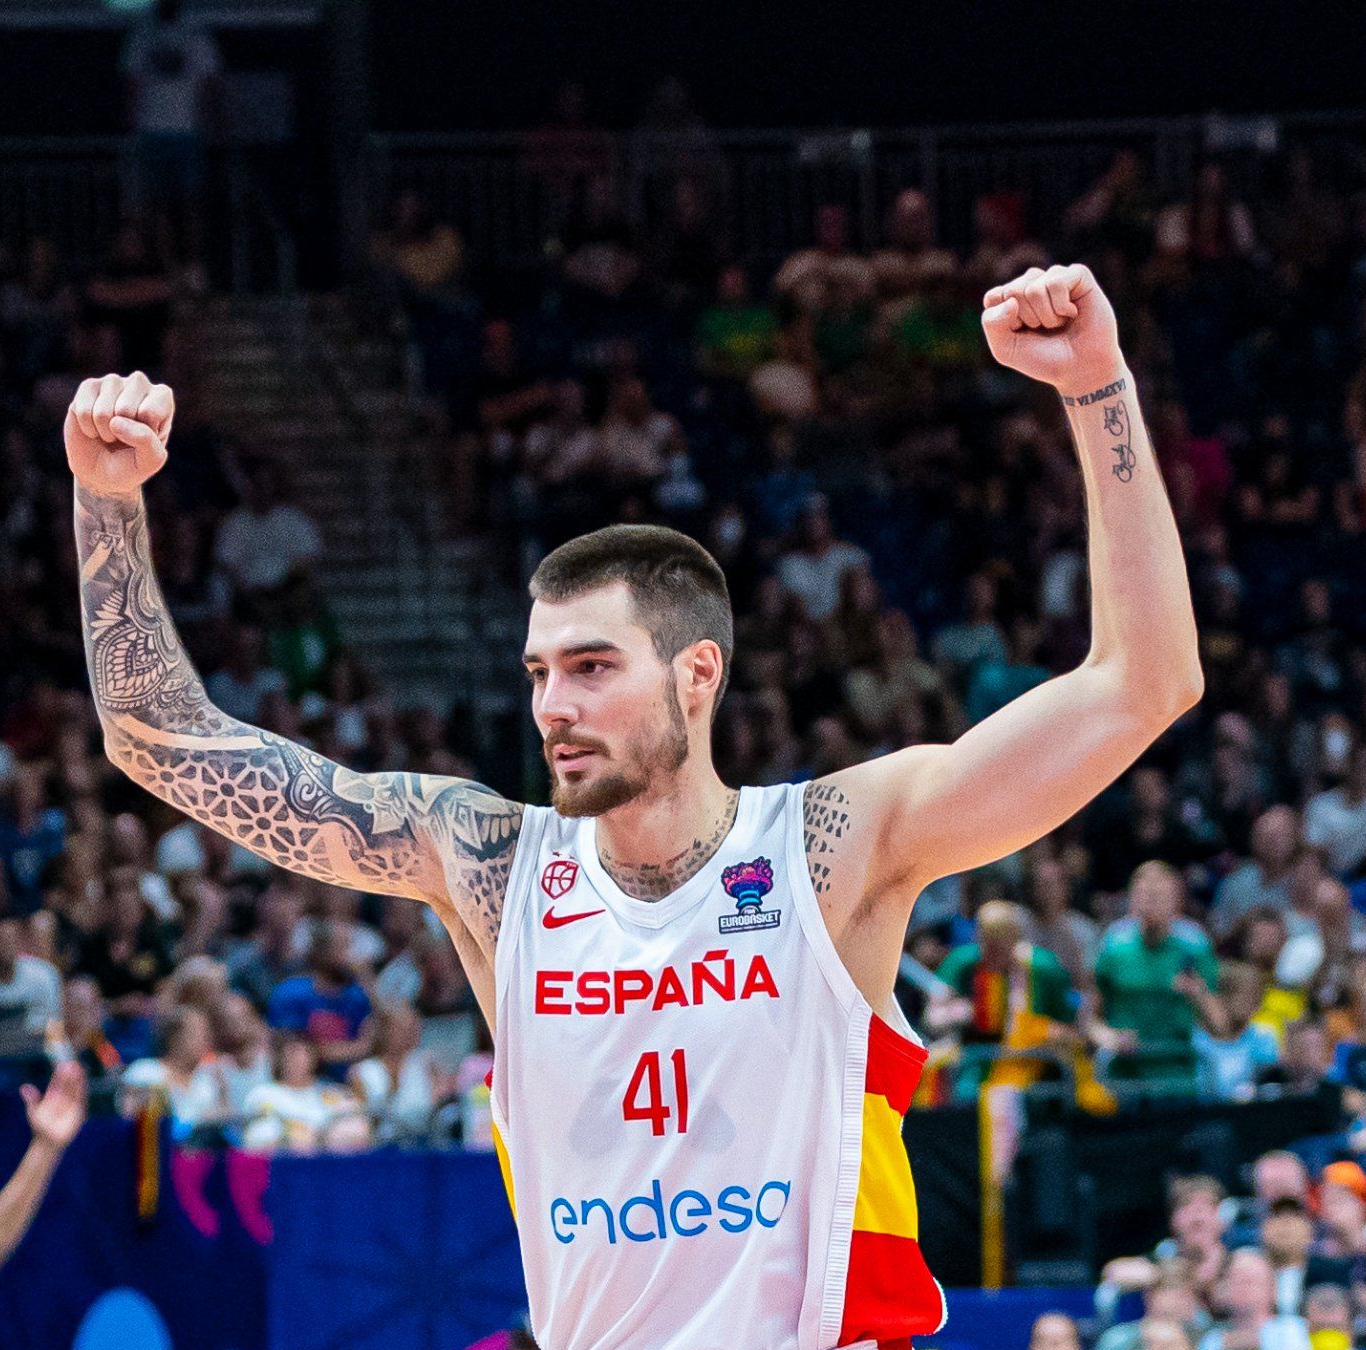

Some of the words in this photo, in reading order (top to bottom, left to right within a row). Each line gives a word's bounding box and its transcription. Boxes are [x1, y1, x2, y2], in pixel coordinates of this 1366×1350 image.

[720, 912, 780, 928] EUROBASKET
[534, 949, 780, 1015] ESPAÑA
[622, 1048, 688, 1136] 41
[550, 1179, 791, 1244] endesa
